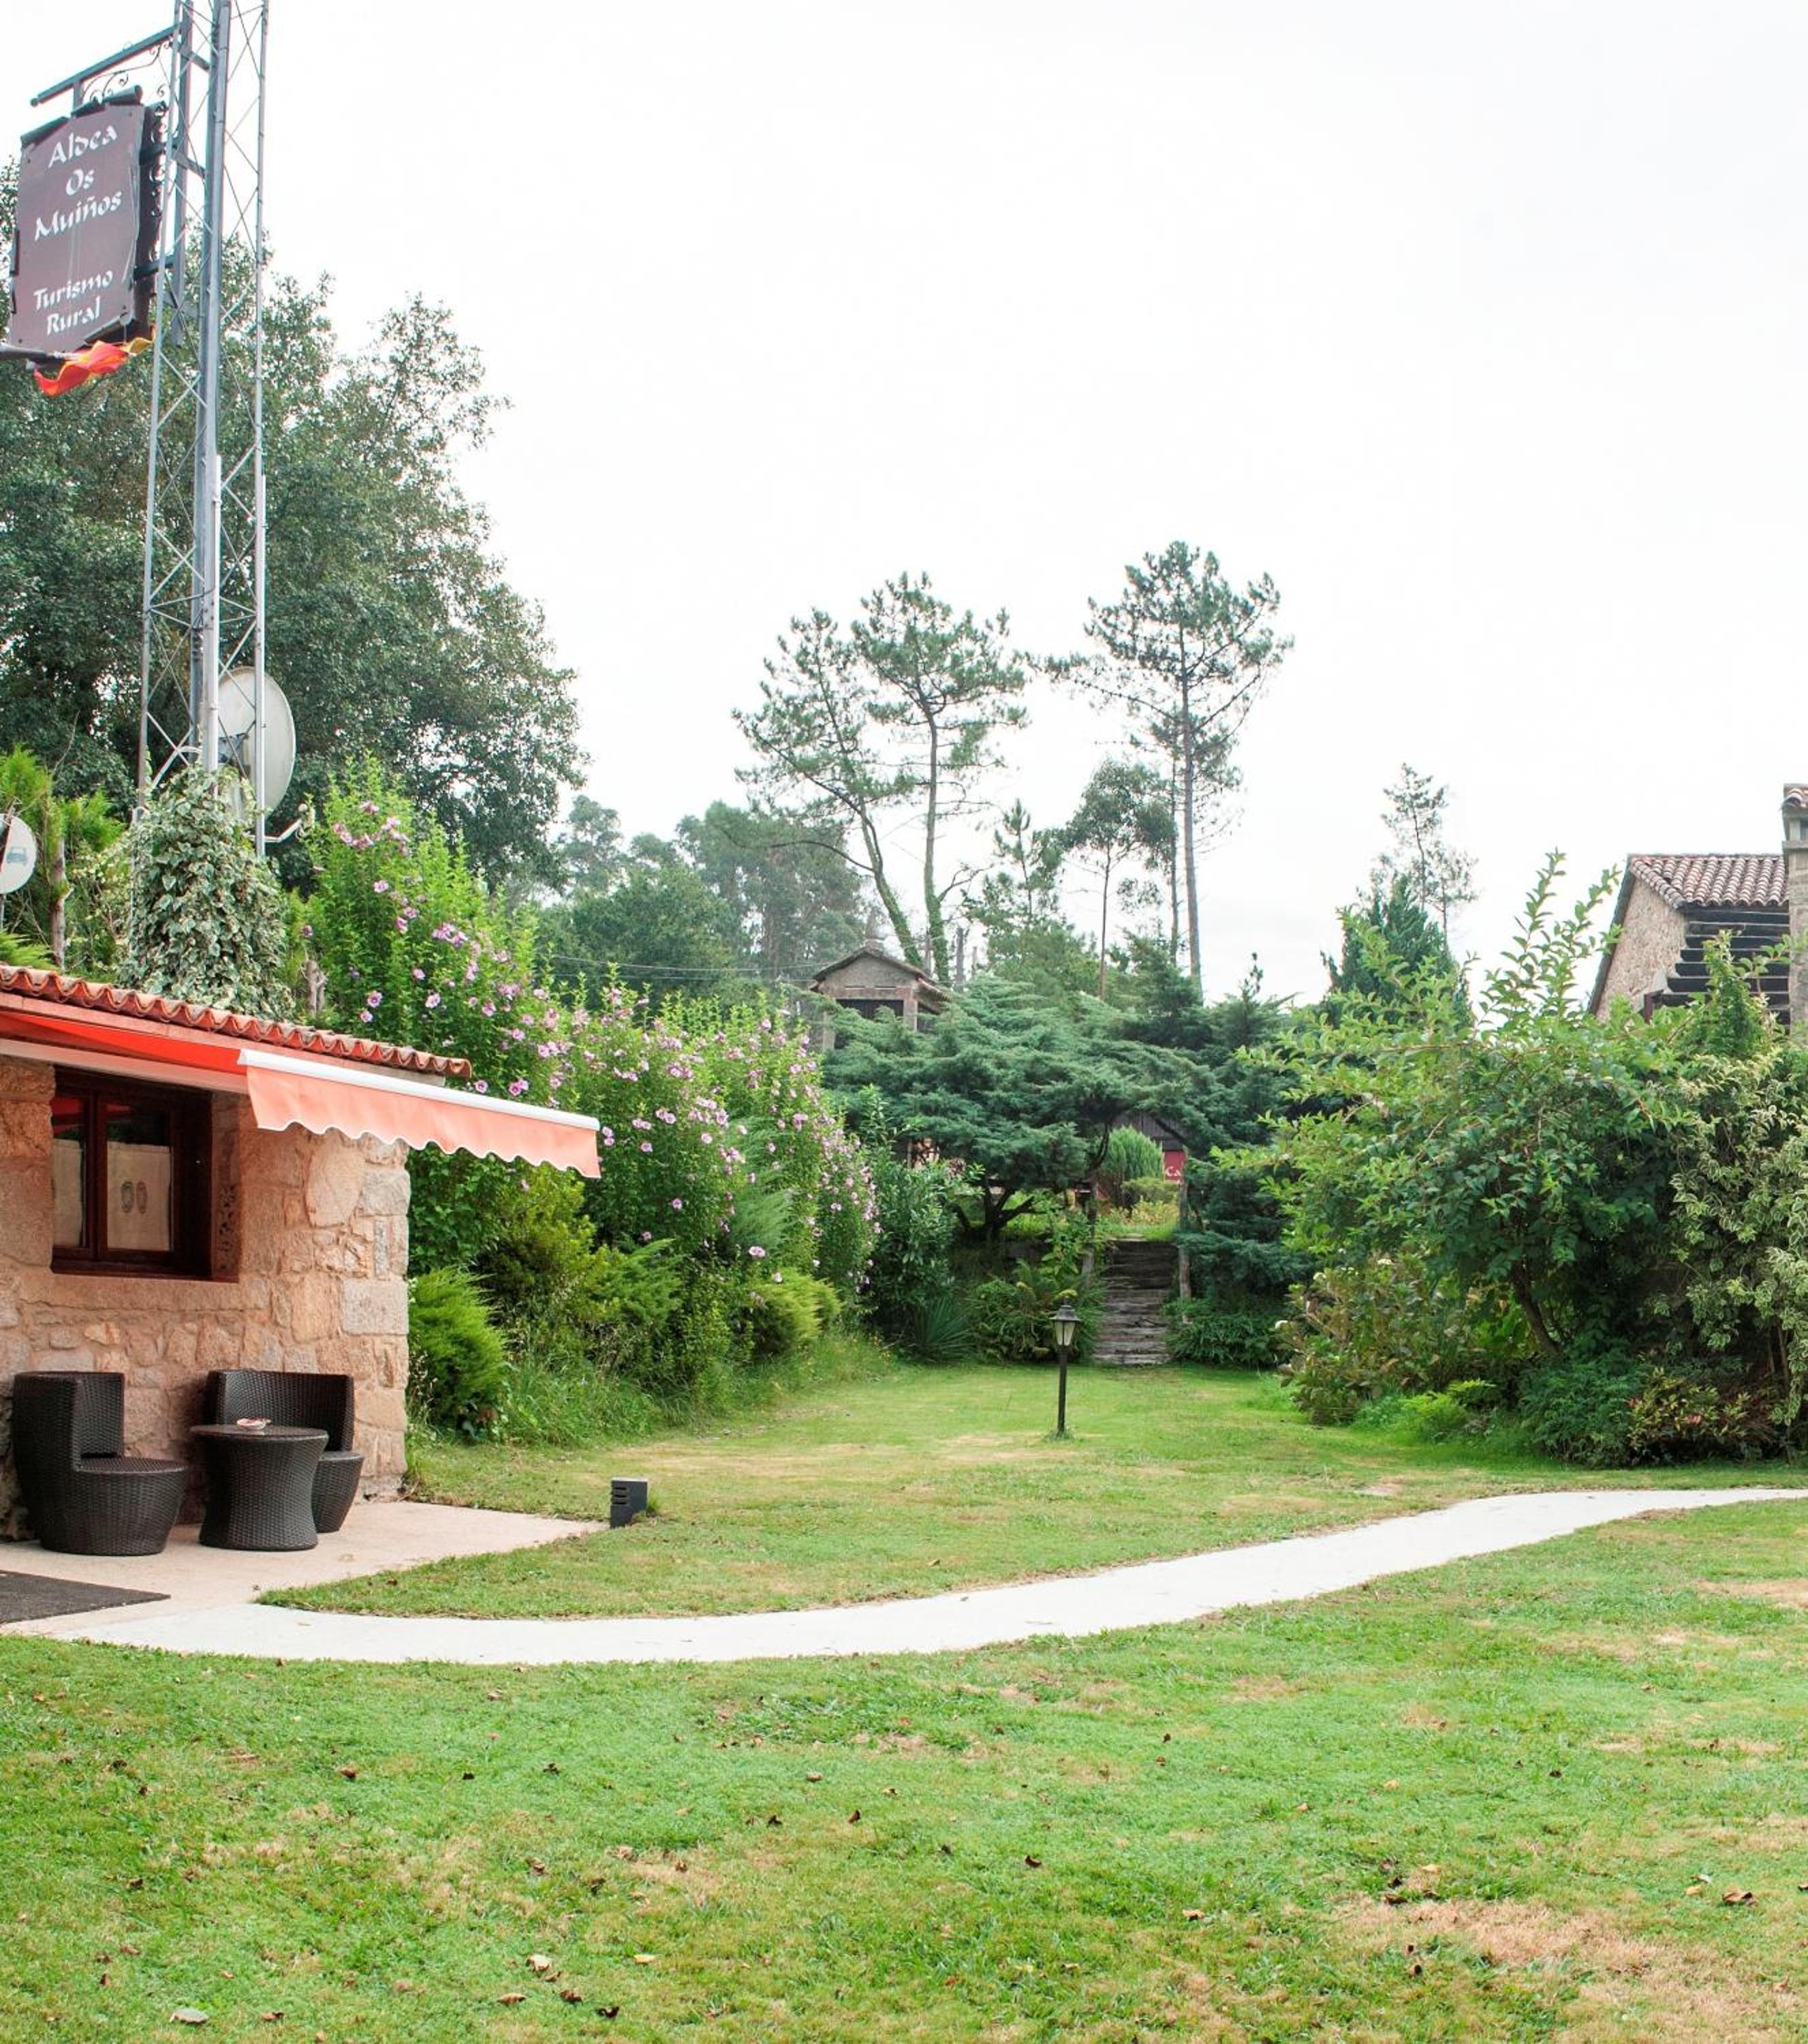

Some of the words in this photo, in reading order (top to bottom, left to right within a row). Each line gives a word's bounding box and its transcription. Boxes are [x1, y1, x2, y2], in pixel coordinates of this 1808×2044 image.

[48, 125, 116, 168] Aldea
[65, 169, 95, 196] Os
[34, 191, 122, 241] Muiños
[33, 270, 113, 311] Turismo
[47, 295, 100, 335] Rural
